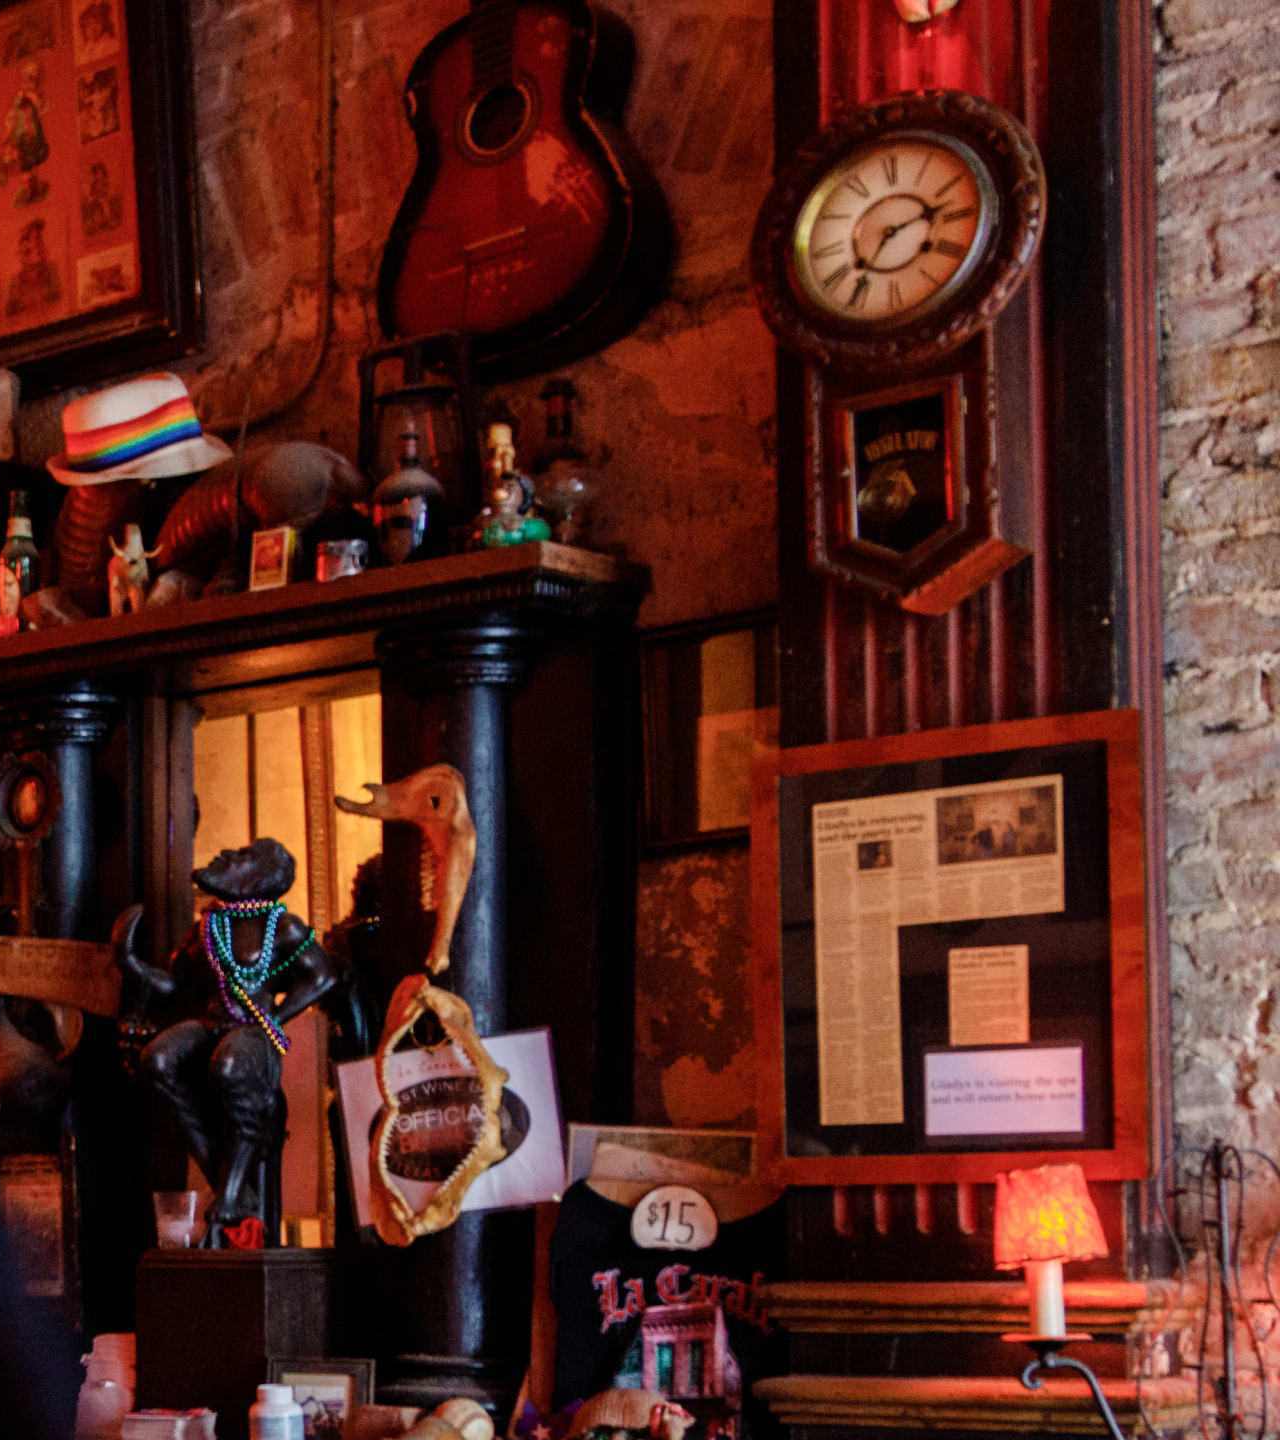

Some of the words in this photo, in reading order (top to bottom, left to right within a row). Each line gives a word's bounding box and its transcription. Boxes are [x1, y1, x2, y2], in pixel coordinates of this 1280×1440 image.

[396, 1102, 487, 1135] OFFICIA
[647, 1201, 697, 1246] $15
[592, 1267, 646, 1335] La
